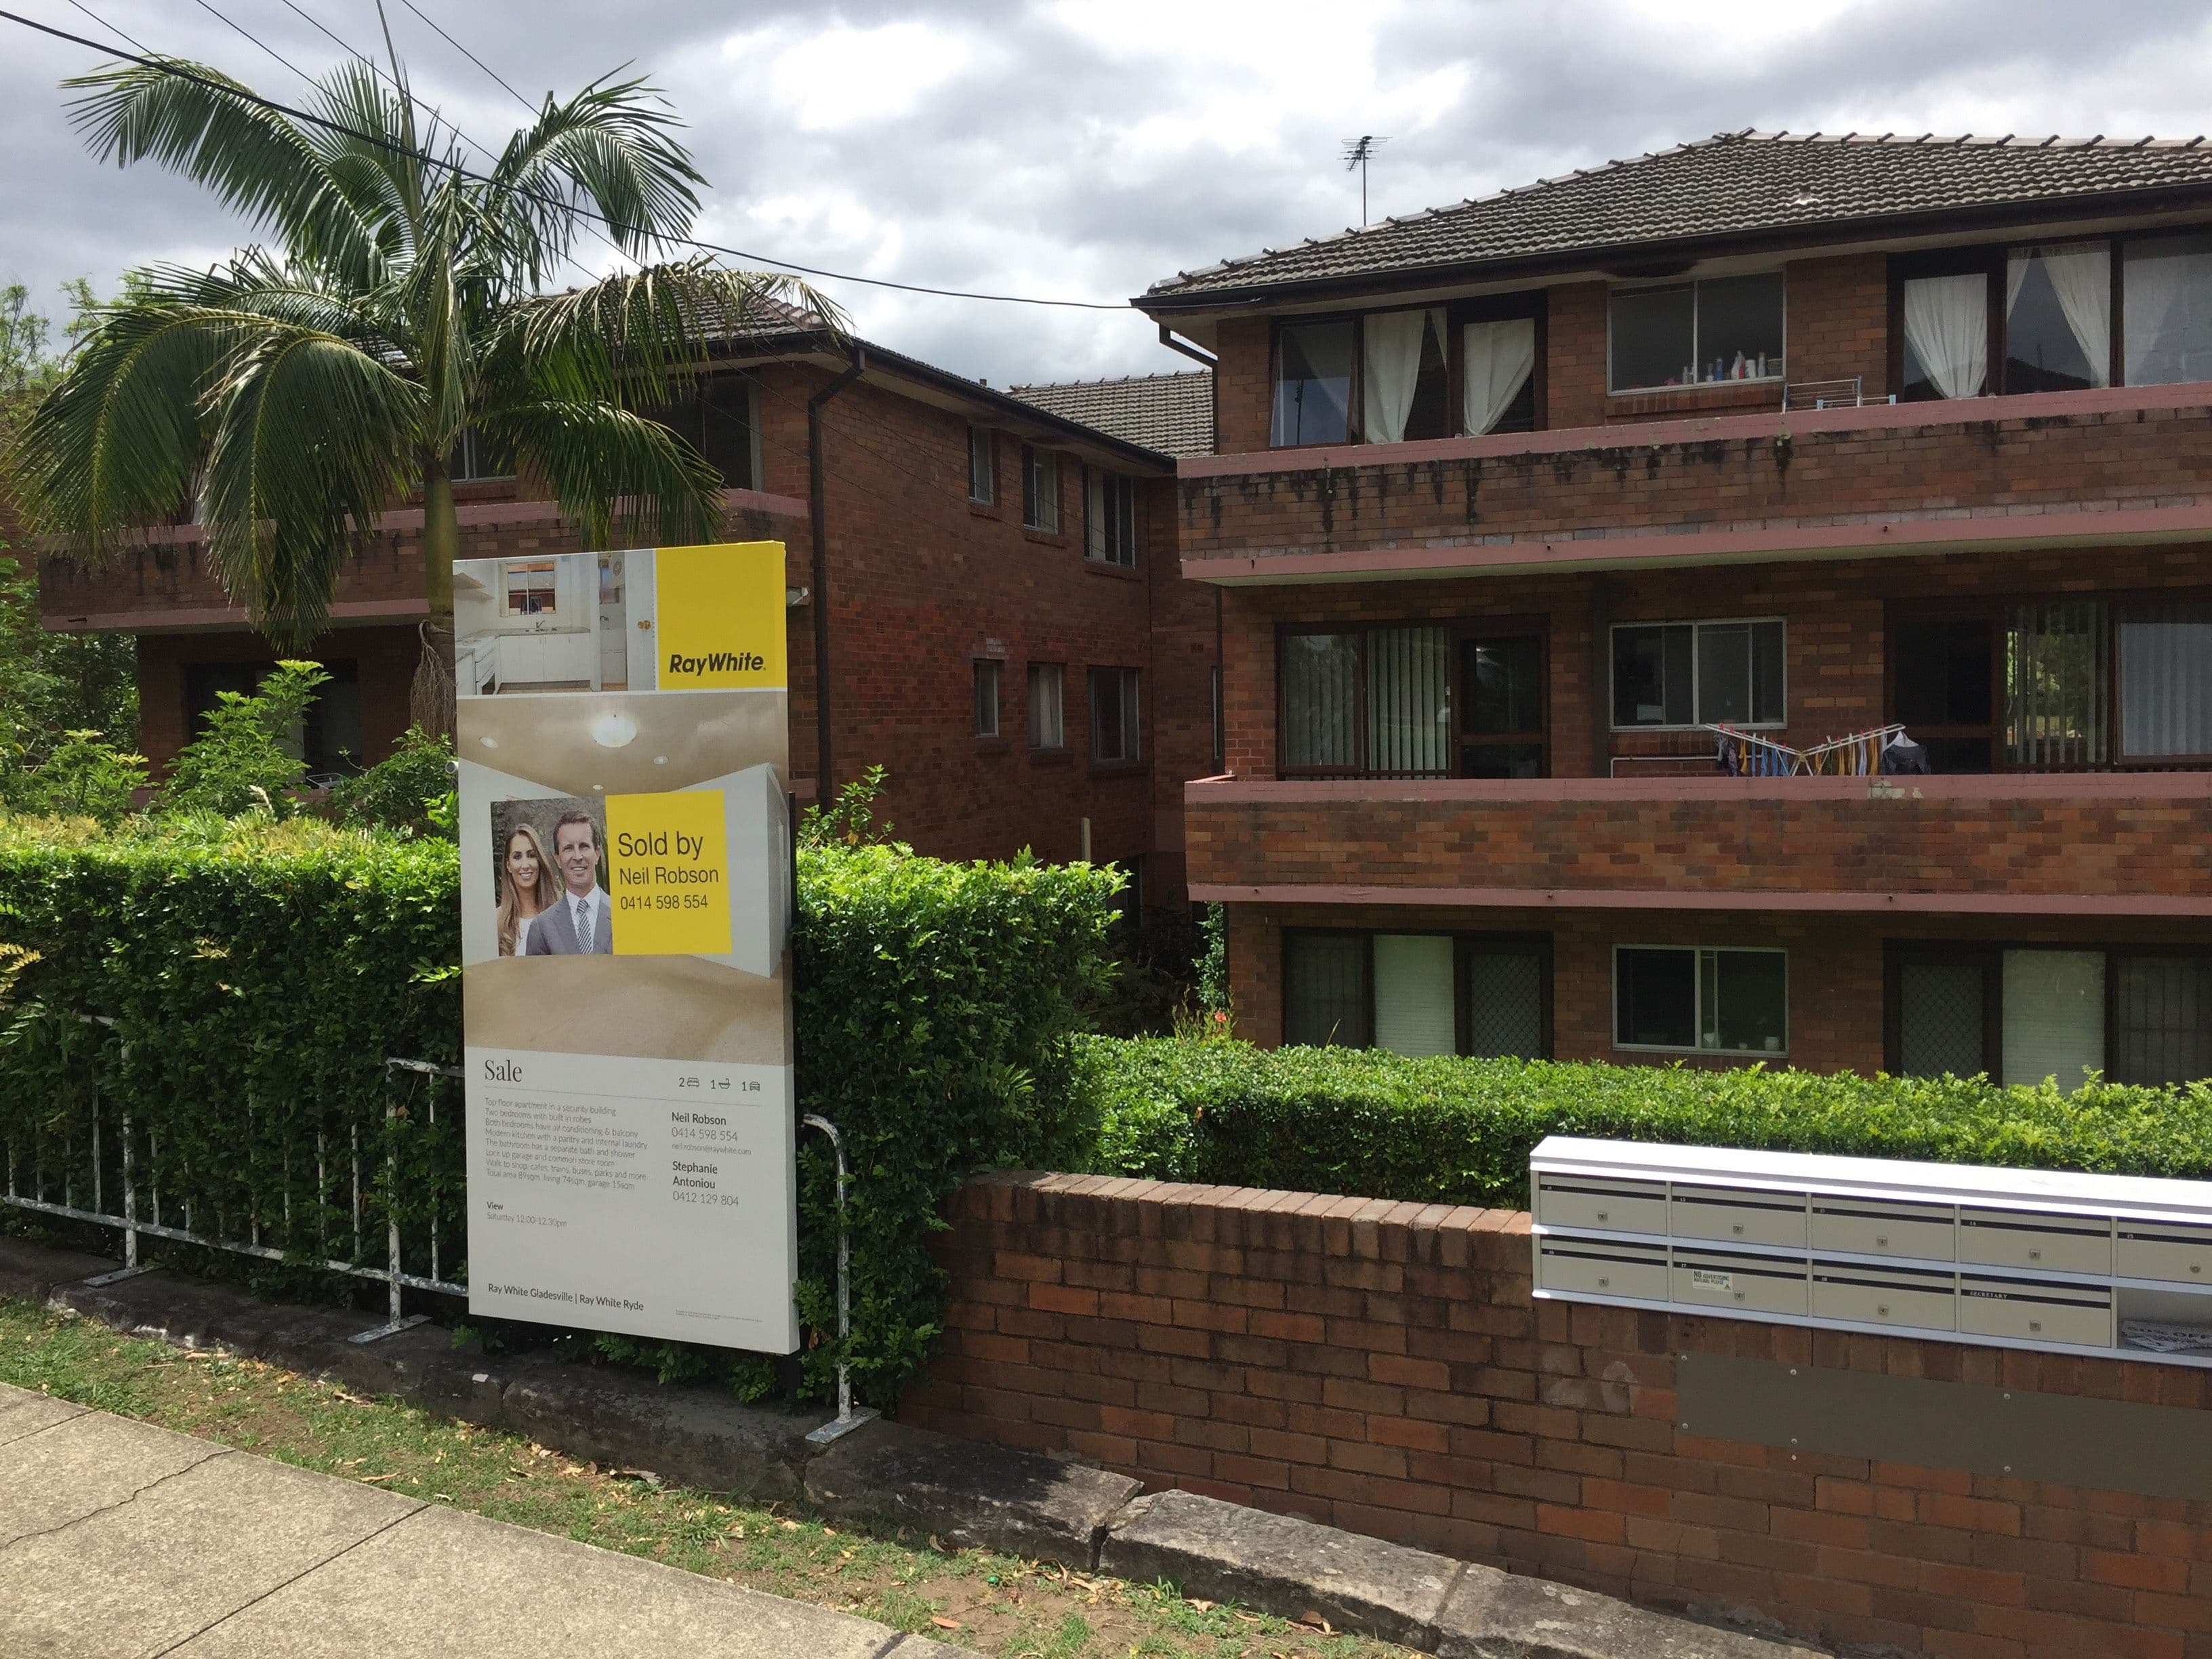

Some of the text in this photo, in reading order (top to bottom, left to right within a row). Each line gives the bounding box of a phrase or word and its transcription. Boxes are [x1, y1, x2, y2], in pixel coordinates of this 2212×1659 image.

[618, 831, 703, 861] Sold by
[619, 866, 719, 885] Neil Robson
[620, 894, 708, 910] 0414 598 554
[485, 1059, 523, 1082] Sale
[678, 1078, 747, 1091] 2 1 1
[485, 1097, 497, 1107] Top
[498, 1099, 512, 1107] floor
[514, 1101, 547, 1110] apartment
[562, 1105, 588, 1114] security
[590, 1105, 617, 1117] building
[485, 1107, 498, 1115] Two
[499, 1109, 531, 1119] bedrooms
[549, 1113, 563, 1122] built
[573, 1115, 592, 1124] robes
[672, 1112, 726, 1126] Neil Robson
[485, 1118, 500, 1126] Both
[501, 1120, 533, 1129] bedrooms
[562, 1125, 603, 1136] conditioning
[605, 1128, 610, 1136] &
[612, 1128, 638, 1139] balcony
[672, 1126, 737, 1141] 0414 598 554
[485, 1128, 510, 1137] Modern
[512, 1130, 535, 1140] kitchen
[558, 1135, 579, 1145] pantry
[581, 1136, 594, 1145] and
[595, 1139, 620, 1147] internal
[622, 1140, 648, 1150] laundry
[485, 1138, 498, 1147] The
[499, 1139, 531, 1149] bathroom
[532, 1143, 543, 1151] has
[550, 1144, 578, 1154] separate
[580, 1146, 594, 1155] bath
[596, 1148, 609, 1156] and
[611, 1149, 635, 1159] shower
[486, 1149, 500, 1157] Lock
[501, 1151, 510, 1159] up
[512, 1152, 533, 1162] garage
[579, 1157, 596, 1166] store
[486, 1159, 501, 1167] Walk
[594, 1169, 613, 1178] parks
[629, 1172, 647, 1181] more
[672, 1160, 718, 1174] Stephanie
[487, 1168, 501, 1177] Total
[543, 1174, 560, 1185] living
[588, 1179, 610, 1188] garage
[612, 1181, 635, 1190] 15sqm
[673, 1176, 716, 1189] Antoniou
[487, 1202, 504, 1210] View
[673, 1190, 739, 1206] 0412 129 804
[487, 1212, 514, 1223] Saturday
[488, 1284, 502, 1294] Ray
[504, 1285, 528, 1297] White
[530, 1288, 573, 1302] Gladesville
[579, 1294, 594, 1307] Ray
[596, 1296, 621, 1308] White
[623, 1300, 644, 1311] Ryde
[1969, 1291, 2007, 1299] SECRETARY
